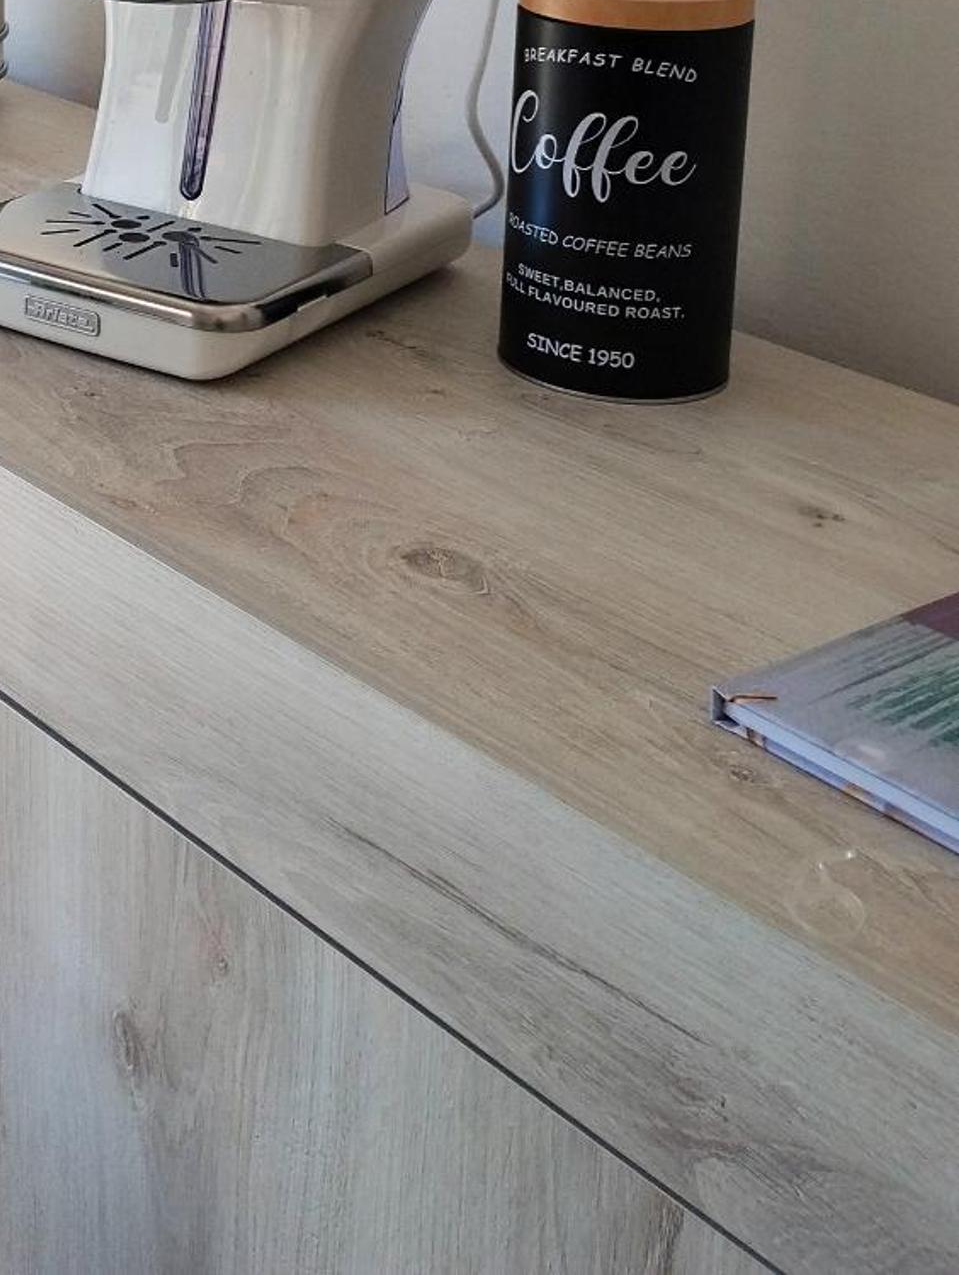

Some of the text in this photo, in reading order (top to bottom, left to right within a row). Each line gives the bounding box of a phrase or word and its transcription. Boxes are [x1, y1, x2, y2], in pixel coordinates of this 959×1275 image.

[525, 47, 697, 83] BREAKFAST BLEND
[511, 89, 697, 203] Coffee
[562, 235, 630, 258] COFFEE
[633, 243, 693, 260] BEANS
[528, 286, 620, 318] FLAVOURED
[625, 306, 686, 319] ROAST.
[526, 332, 635, 369] SINCE 1950
